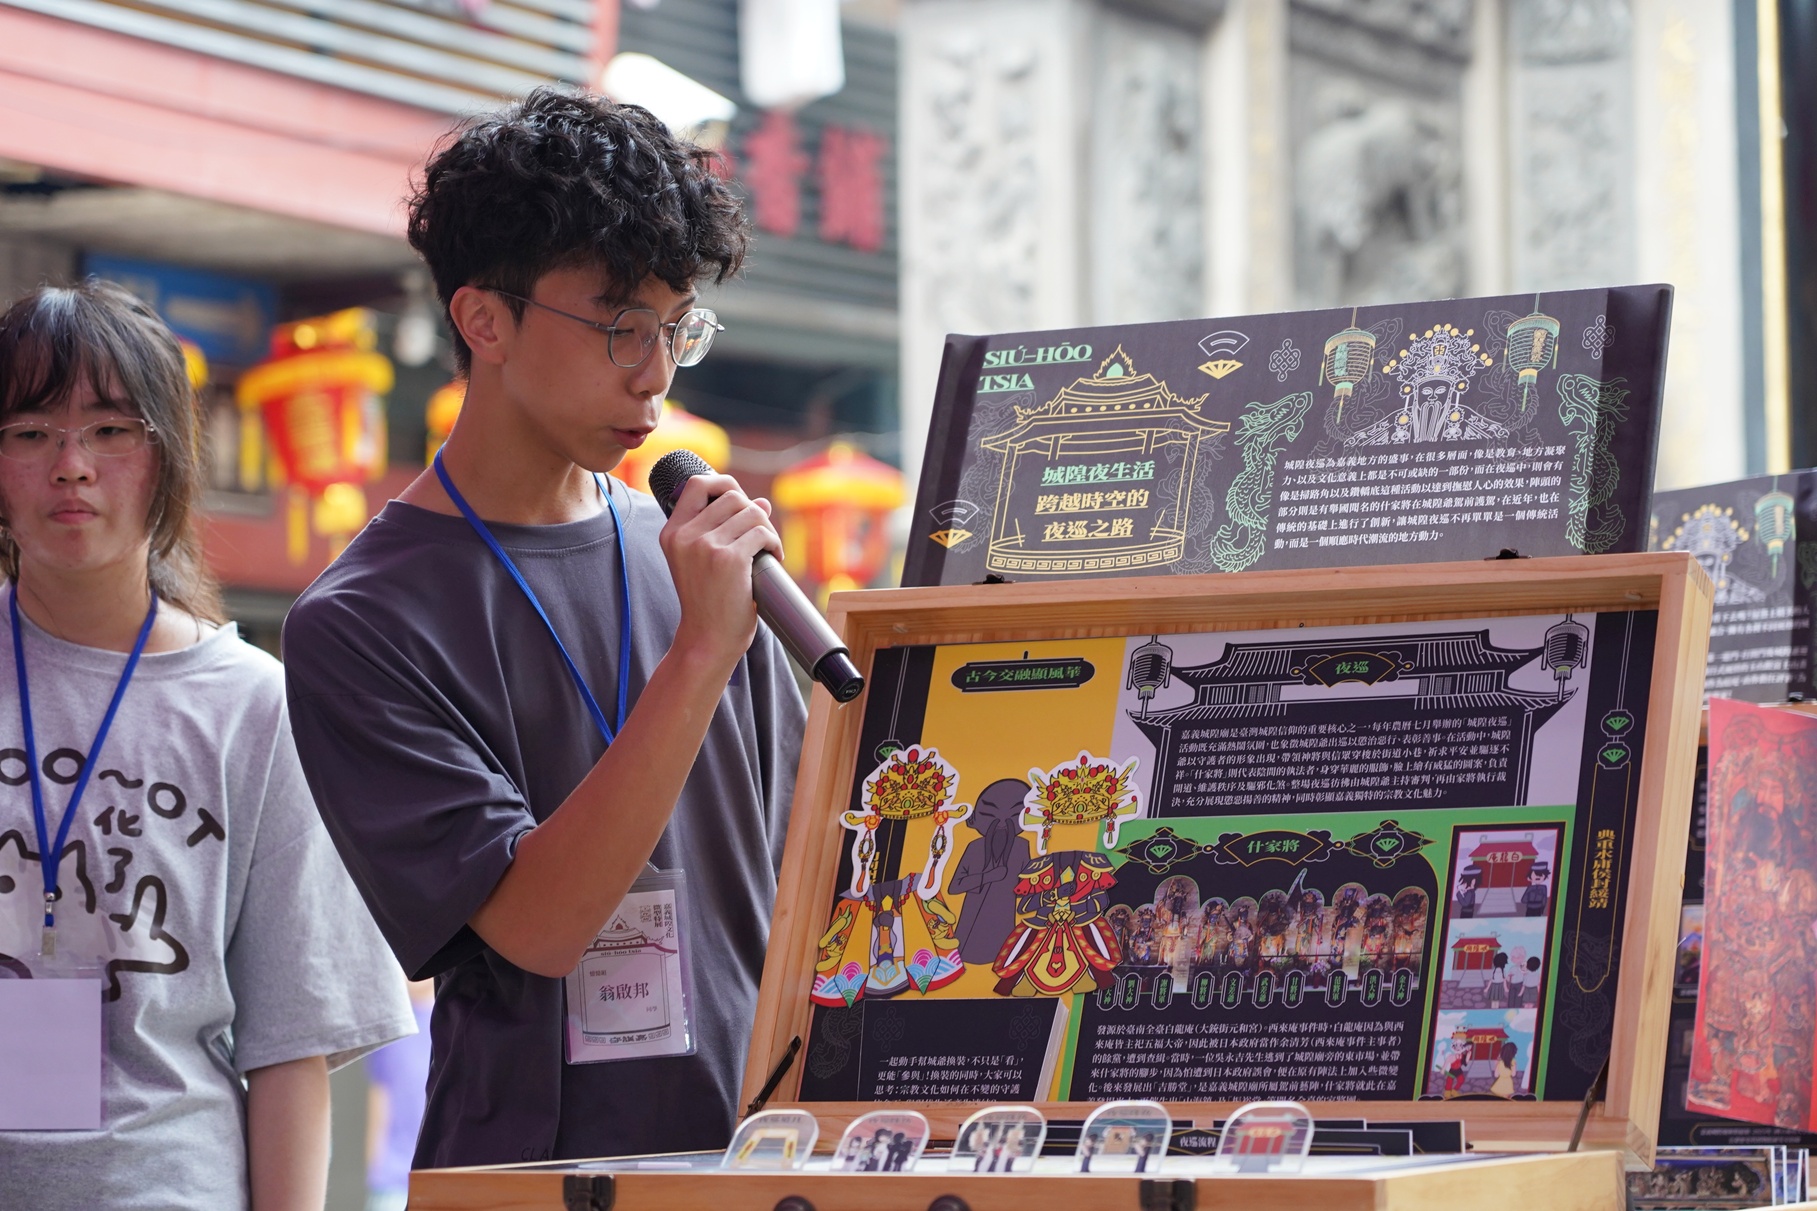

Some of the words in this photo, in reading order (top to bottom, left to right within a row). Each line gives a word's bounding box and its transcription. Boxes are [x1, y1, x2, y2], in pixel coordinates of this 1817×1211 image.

[979, 372, 1034, 391] TSIA
[1042, 460, 1155, 484] 城隍夜生活
[1036, 488, 1149, 513] 跨越時空的
[1044, 518, 1134, 541] 夜巡之路
[966, 666, 1081, 683] 古今交融顯風華
[1335, 661, 1369, 674] 夜巡
[1247, 839, 1300, 853] 什家將
